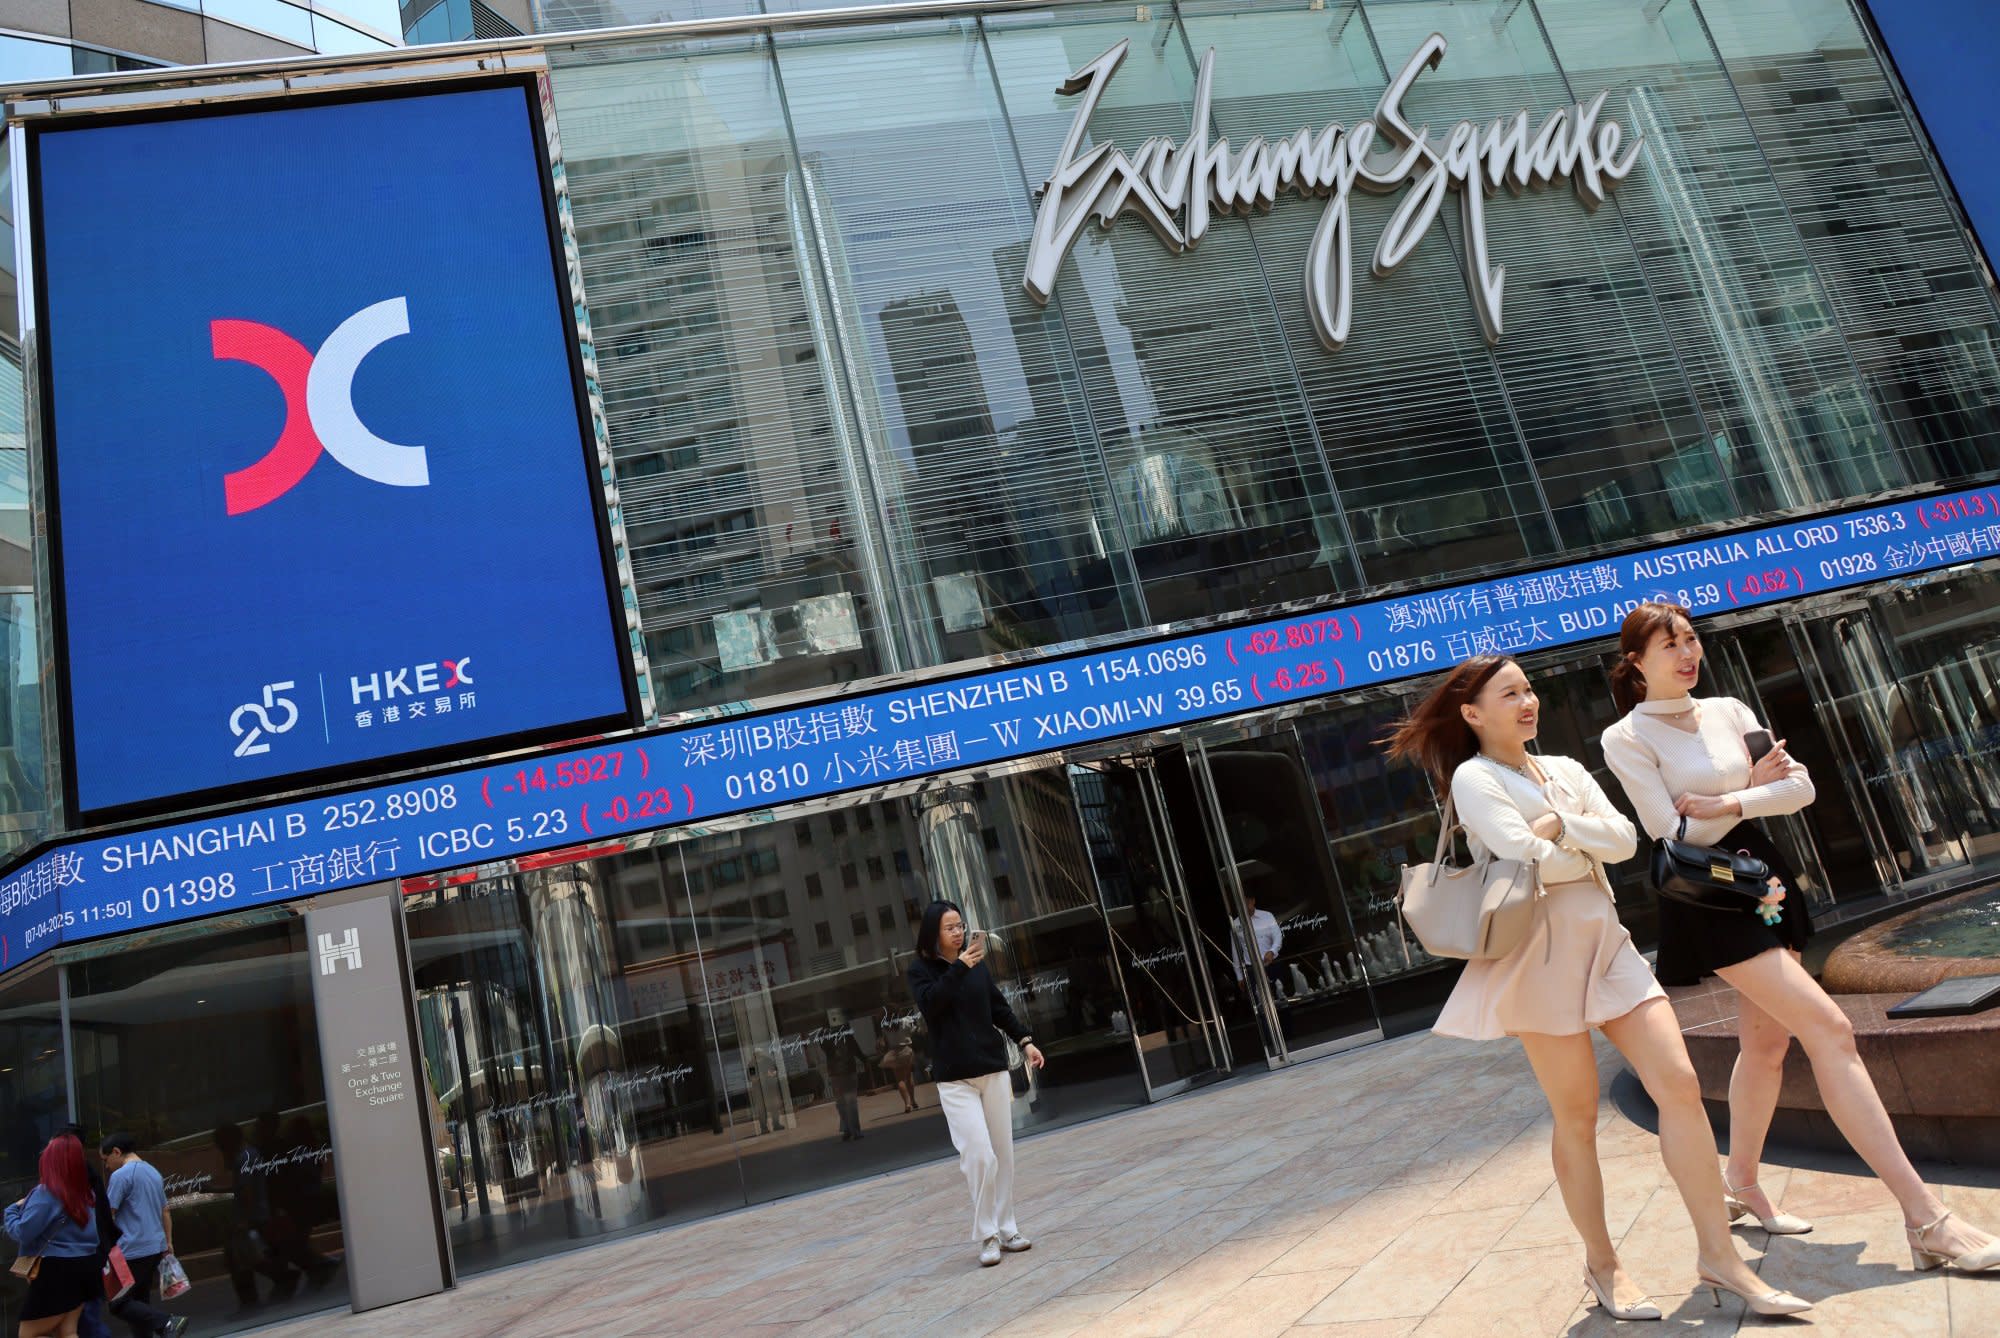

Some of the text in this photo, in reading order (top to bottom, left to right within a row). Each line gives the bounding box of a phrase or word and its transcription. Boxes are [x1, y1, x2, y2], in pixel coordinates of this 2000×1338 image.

[1023, 31, 1646, 352] Exchange Square
[1384, 564, 1623, 633] 澳洲所有普通股指數
[1634, 542, 1750, 581] AUSTRALIA
[1756, 526, 1792, 557] ALL
[1794, 522, 1839, 548] ORD
[1843, 511, 1907, 539] 7536.3
[1820, 552, 1877, 580] 01928
[1367, 640, 1436, 672] 01876
[1442, 616, 1553, 662] 百威亞太
[1558, 607, 1607, 633] BUD
[1677, 583, 1720, 609] 8.59
[350, 656, 474, 705] HKEX
[355, 691, 477, 728] 香港交易所
[681, 703, 878, 768] 深圳B股指數
[888, 673, 1044, 724] SHENZHEN
[1049, 670, 1069, 693] B
[1081, 644, 1207, 686] 1154.0696
[725, 762, 809, 799] 01810
[1033, 693, 1162, 739] XIAOMI-W
[1175, 678, 1242, 712] 39.65
[102, 818, 276, 873] SHANGHAI
[286, 814, 307, 838] B
[323, 784, 457, 831] 252.8908
[142, 872, 236, 914] 01398
[252, 838, 401, 896] 工商銀行
[418, 823, 494, 860] ICBC
[507, 808, 568, 842] 5.23
[348, 1071, 401, 1088] One & Two
[355, 1081, 402, 1098] Exchange
[369, 1092, 404, 1106] Square
